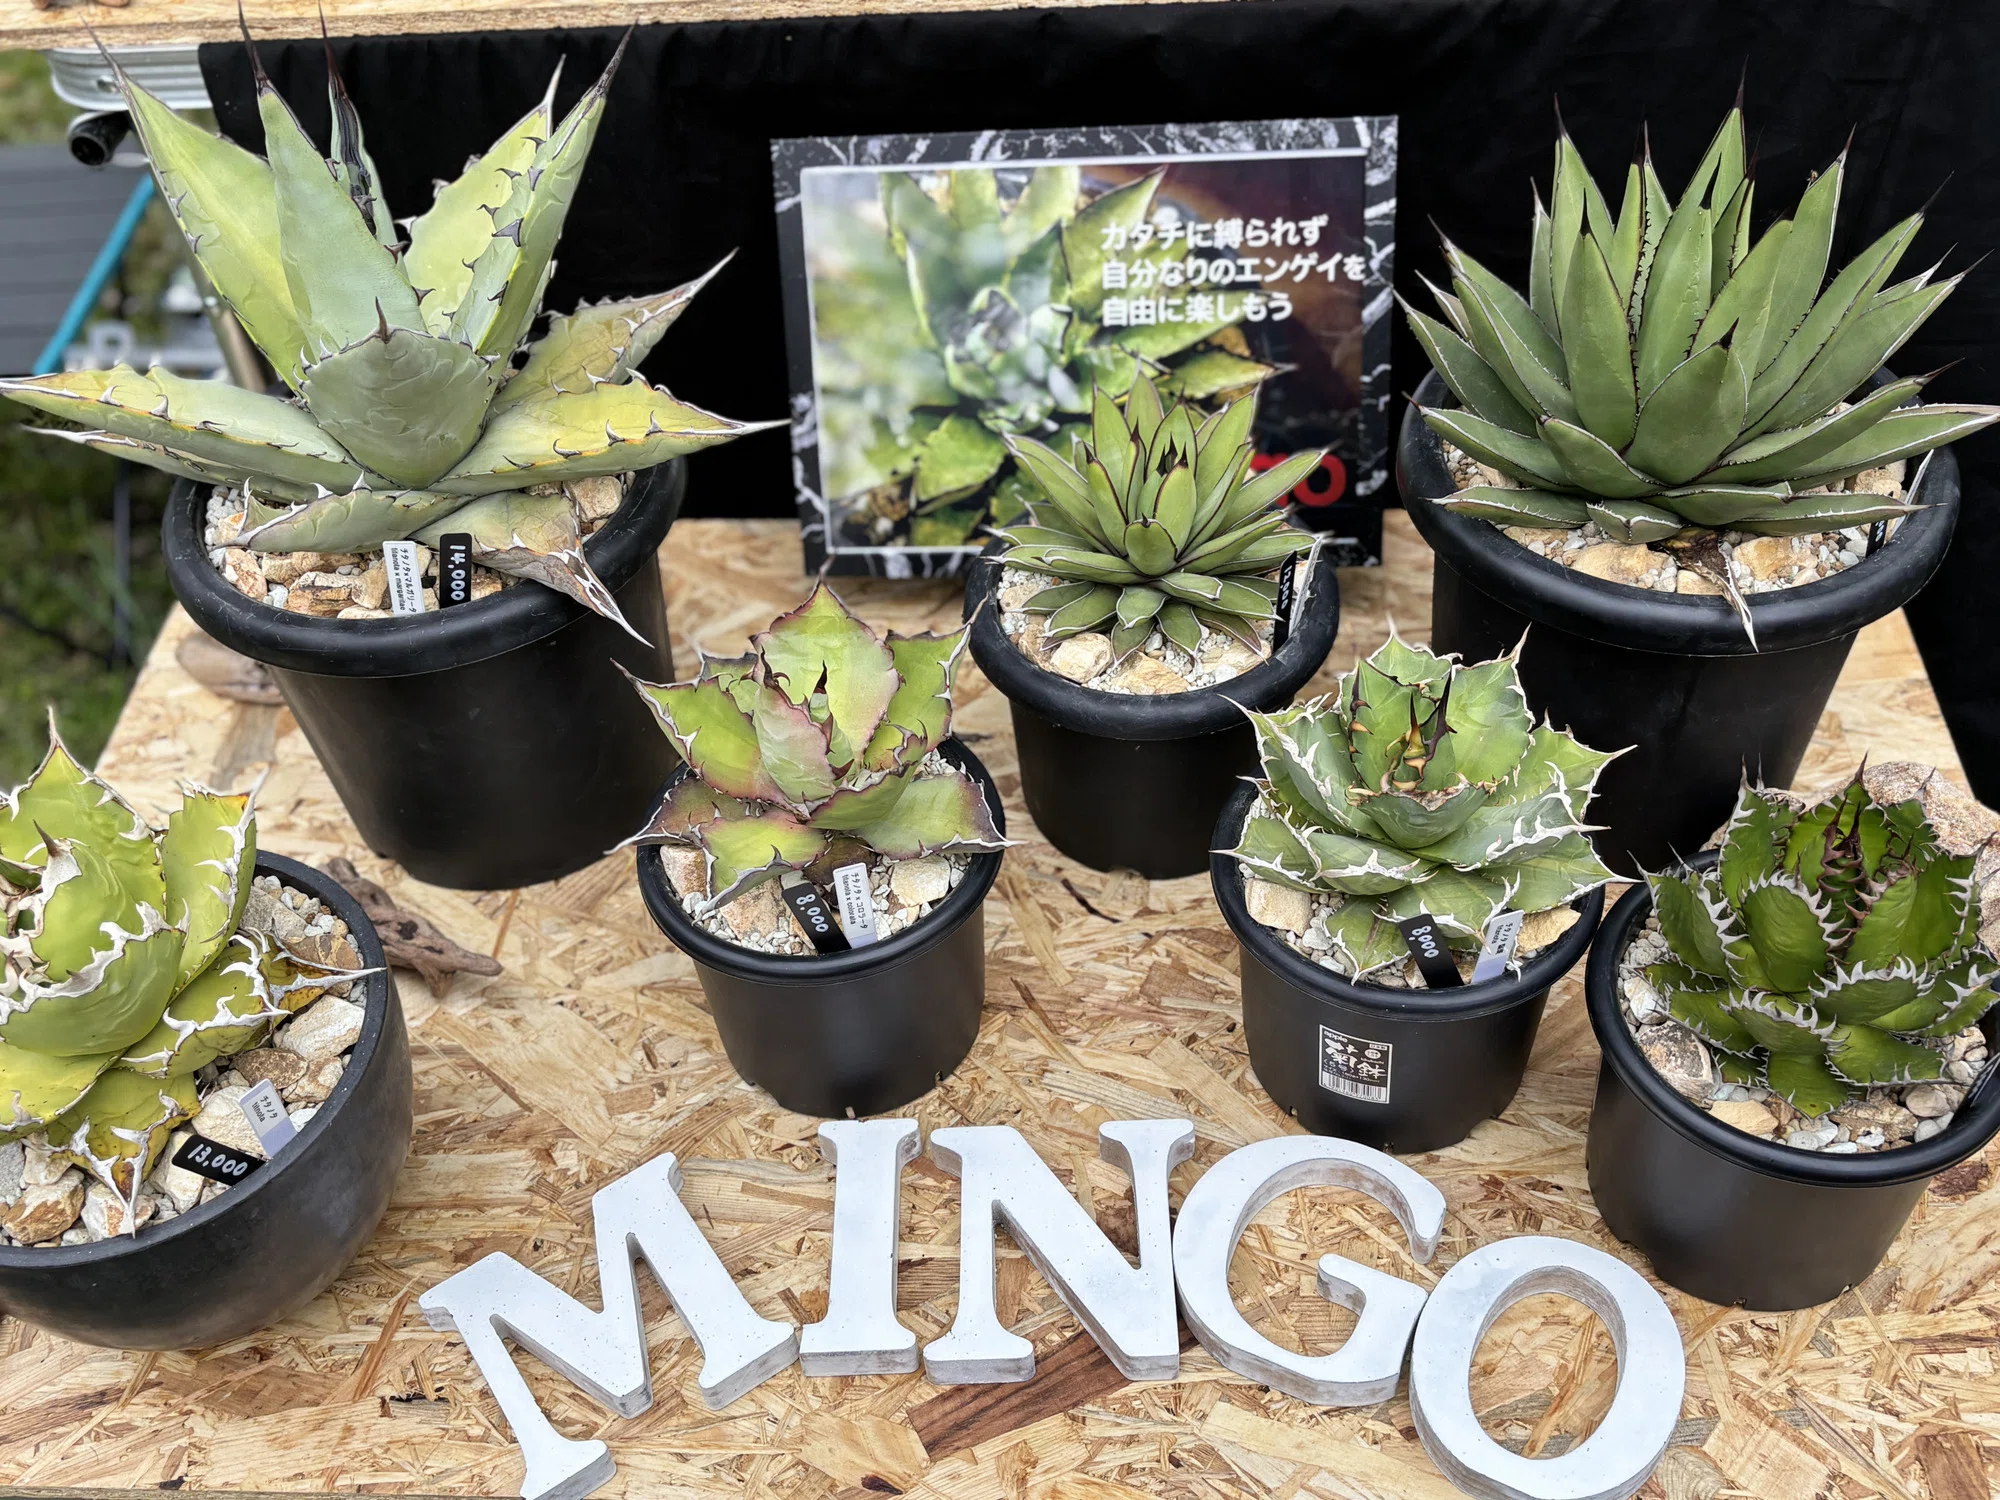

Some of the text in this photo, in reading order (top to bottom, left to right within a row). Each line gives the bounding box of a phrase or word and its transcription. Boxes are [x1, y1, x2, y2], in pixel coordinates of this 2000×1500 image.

[1101, 215, 1328, 250] カタチに縛られず
[1102, 253, 1366, 290] 自分なりのエンゲイを
[1102, 293, 1293, 327] 自由に楽しもう
[448, 545, 466, 601] 14,000
[260, 1095, 278, 1119] チタノタ
[187, 1143, 248, 1177] 13,000
[419, 1118, 1687, 1500] MINGO
